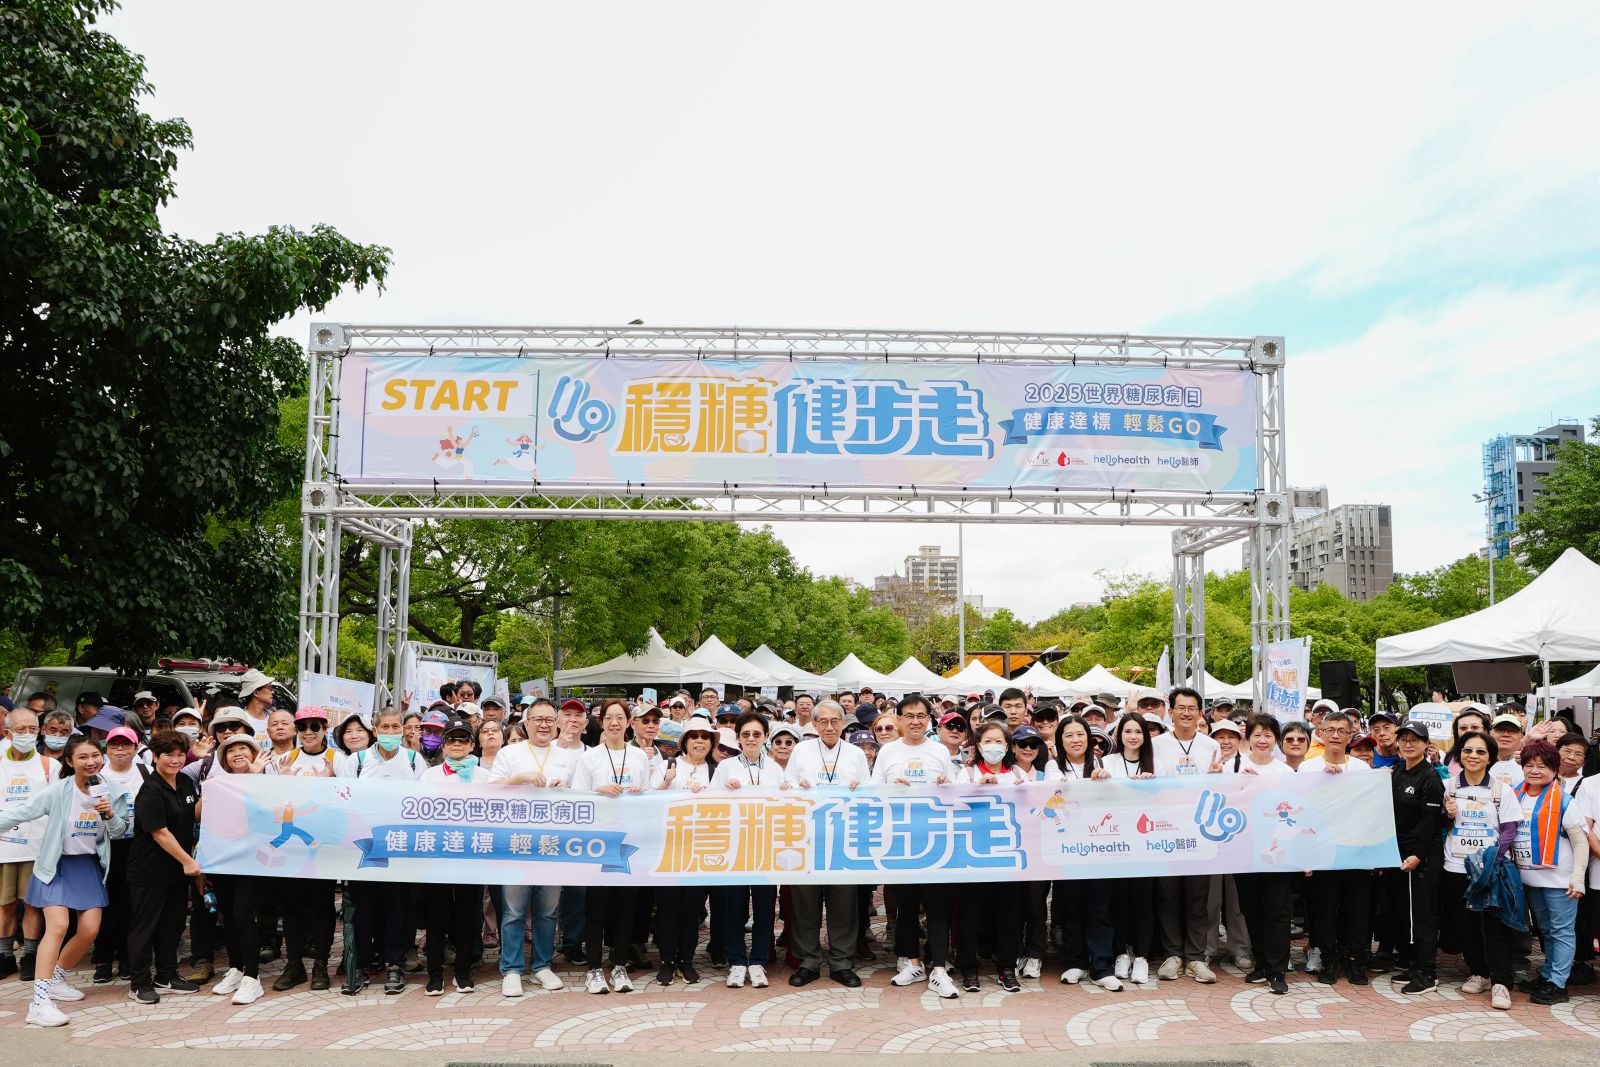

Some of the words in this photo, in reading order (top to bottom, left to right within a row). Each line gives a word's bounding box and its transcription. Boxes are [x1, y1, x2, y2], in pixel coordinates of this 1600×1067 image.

[381, 379, 519, 412] START
[1025, 383, 1202, 407] 2025世界糖尿病日
[615, 378, 992, 457] 穩糖健步走
[1023, 411, 1111, 431] 健康達標
[1123, 413, 1201, 436] 輕鬆GO
[1093, 454, 1150, 467] hellohealth
[1157, 456, 1199, 468] hello醫師
[402, 797, 595, 825] 2025世界糖尿病日
[384, 829, 495, 855] 健康達標
[509, 831, 607, 858] 輕鬆GO
[654, 797, 1022, 873] 穩糖健步走
[1062, 841, 1130, 856] hellohealth
[1146, 838, 1197, 853] hello醫師
[1460, 838, 1485, 847] 0401
